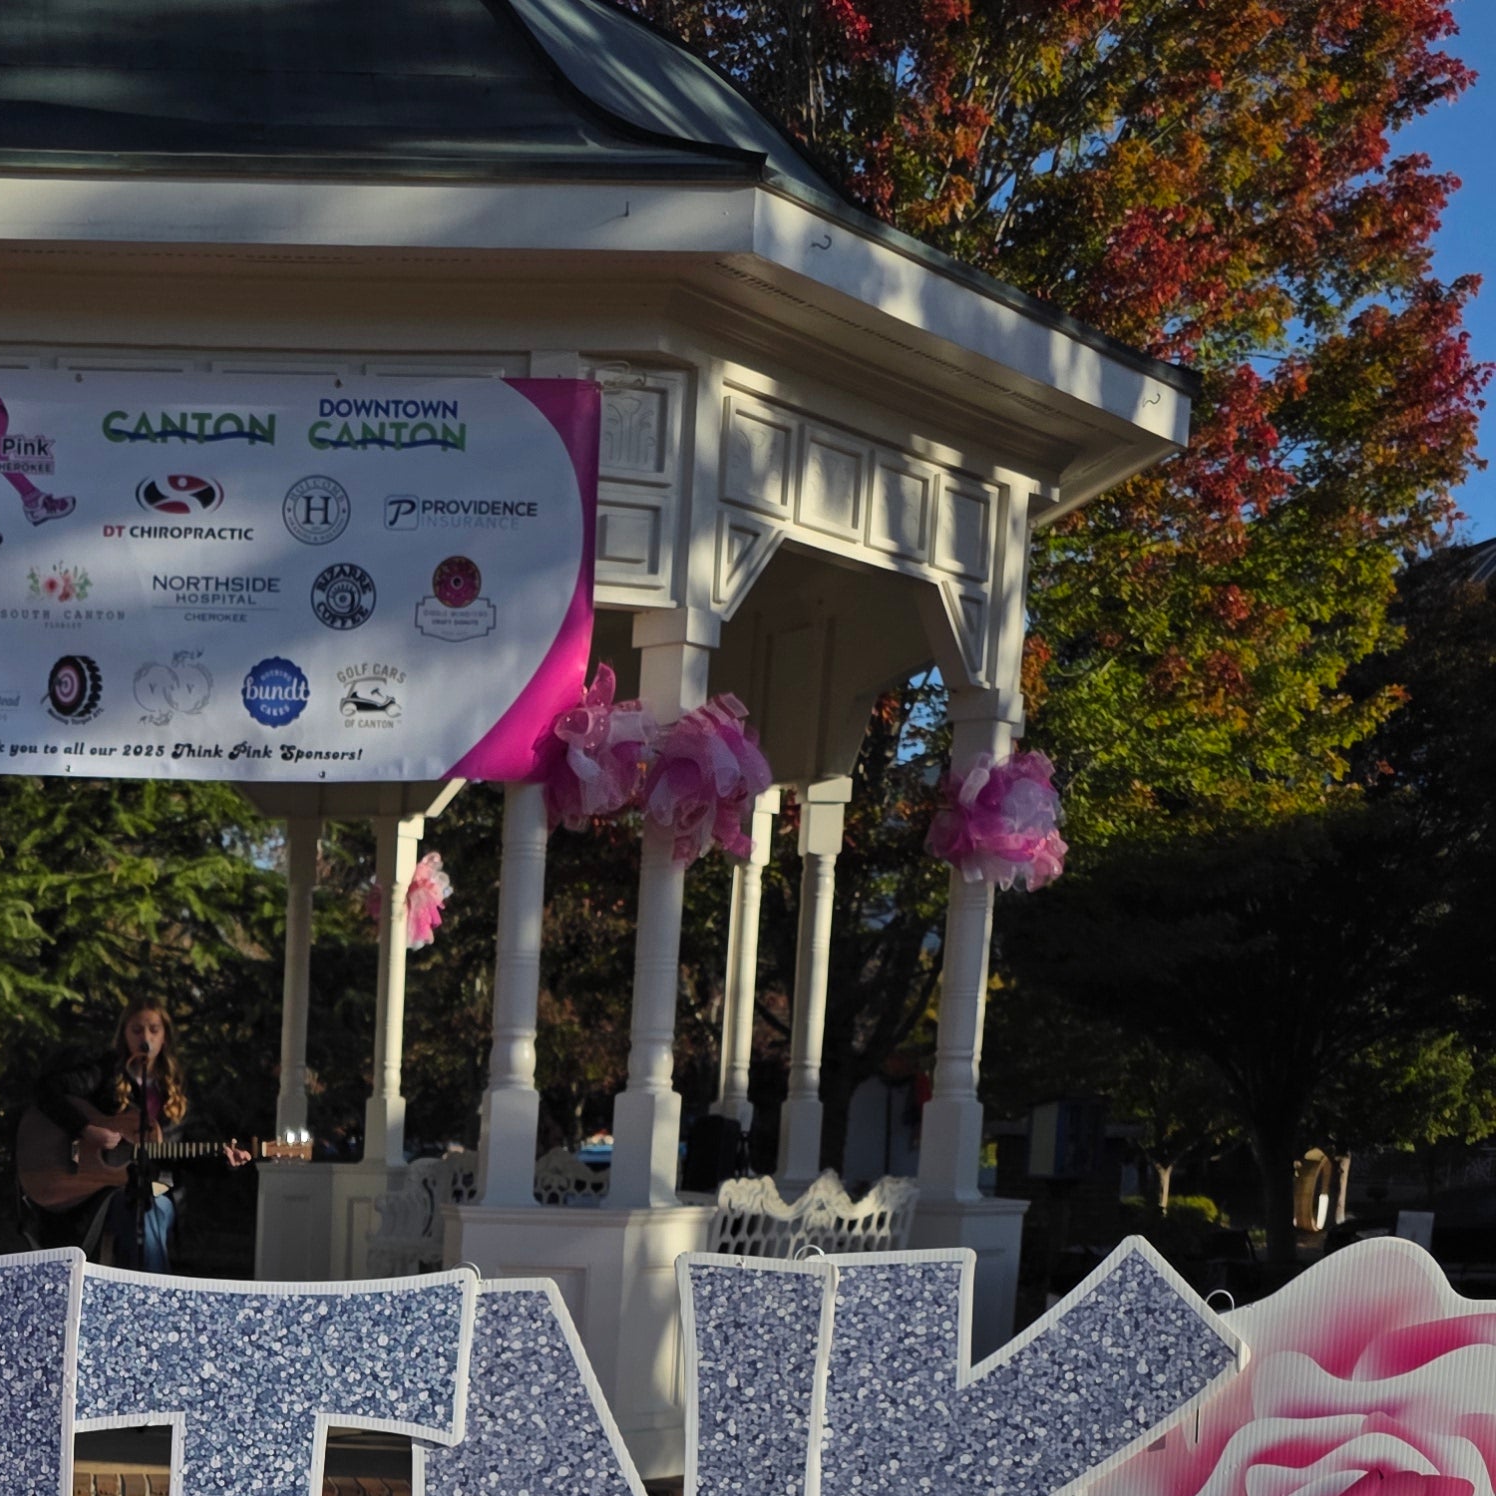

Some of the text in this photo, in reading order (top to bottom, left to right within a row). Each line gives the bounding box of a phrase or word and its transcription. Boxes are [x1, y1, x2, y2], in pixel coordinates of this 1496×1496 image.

[319, 399, 459, 420] DOWNTOWN
[102, 410, 277, 446] CANTON
[308, 420, 466, 452] CANTON
[3, 438, 50, 457] Pink
[302, 495, 332, 525] H
[421, 499, 539, 518] PROVIDENCE
[103, 525, 254, 541] DT CHIROPRACTIC
[421, 515, 520, 532] INSURANCE
[153, 575, 281, 593] NORTHSIDE
[315, 564, 373, 595] BIZARRE
[176, 593, 257, 605] HOSPITAL
[0, 608, 126, 620] SOUTH CANTON
[184, 612, 248, 623] CHEROKEE
[316, 601, 369, 628] COFFEE
[337, 663, 407, 684] GOLF CARS
[245, 675, 307, 701] bundt
[344, 719, 394, 729] OF CANTON
[9, 743, 38, 757] you
[43, 743, 58, 755] to
[63, 742, 84, 756] all
[90, 746, 117, 757] our
[122, 744, 165, 757] 2025
[171, 742, 223, 759] Think
[228, 741, 273, 760] Pink
[279, 742, 363, 763] Sponsors!
